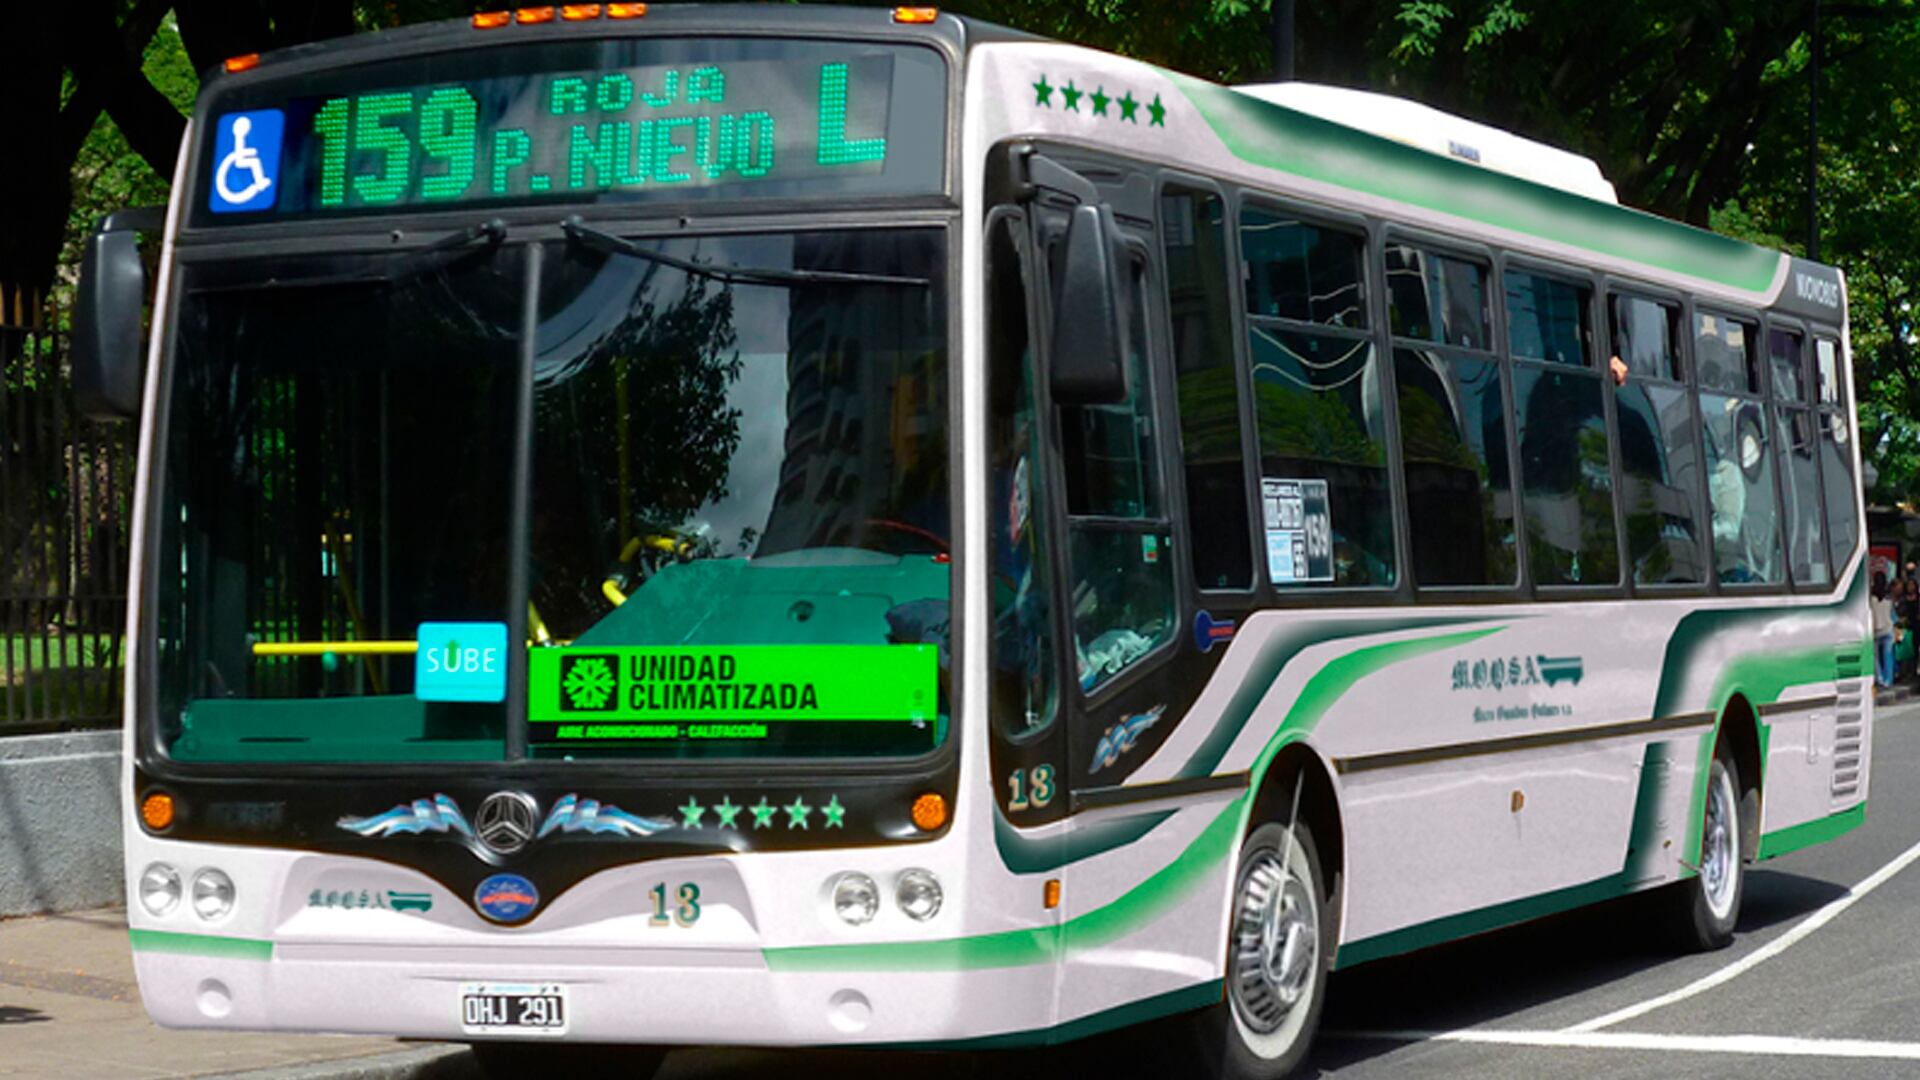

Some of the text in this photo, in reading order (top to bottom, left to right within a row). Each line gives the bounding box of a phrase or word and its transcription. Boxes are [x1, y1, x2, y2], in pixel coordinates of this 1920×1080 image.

[551, 65, 727, 115] ROJA
[817, 62, 886, 165] L
[314, 87, 477, 205] 159
[491, 111, 775, 193] P. NUEVO
[1303, 514, 1329, 557] 159
[426, 644, 496, 673] SUBE
[629, 655, 736, 682] UNIDAD
[628, 683, 819, 711] CLIMATIZADA
[1008, 763, 1056, 812] 13
[648, 882, 701, 928] 13
[466, 996, 563, 1025] OHJ 291
